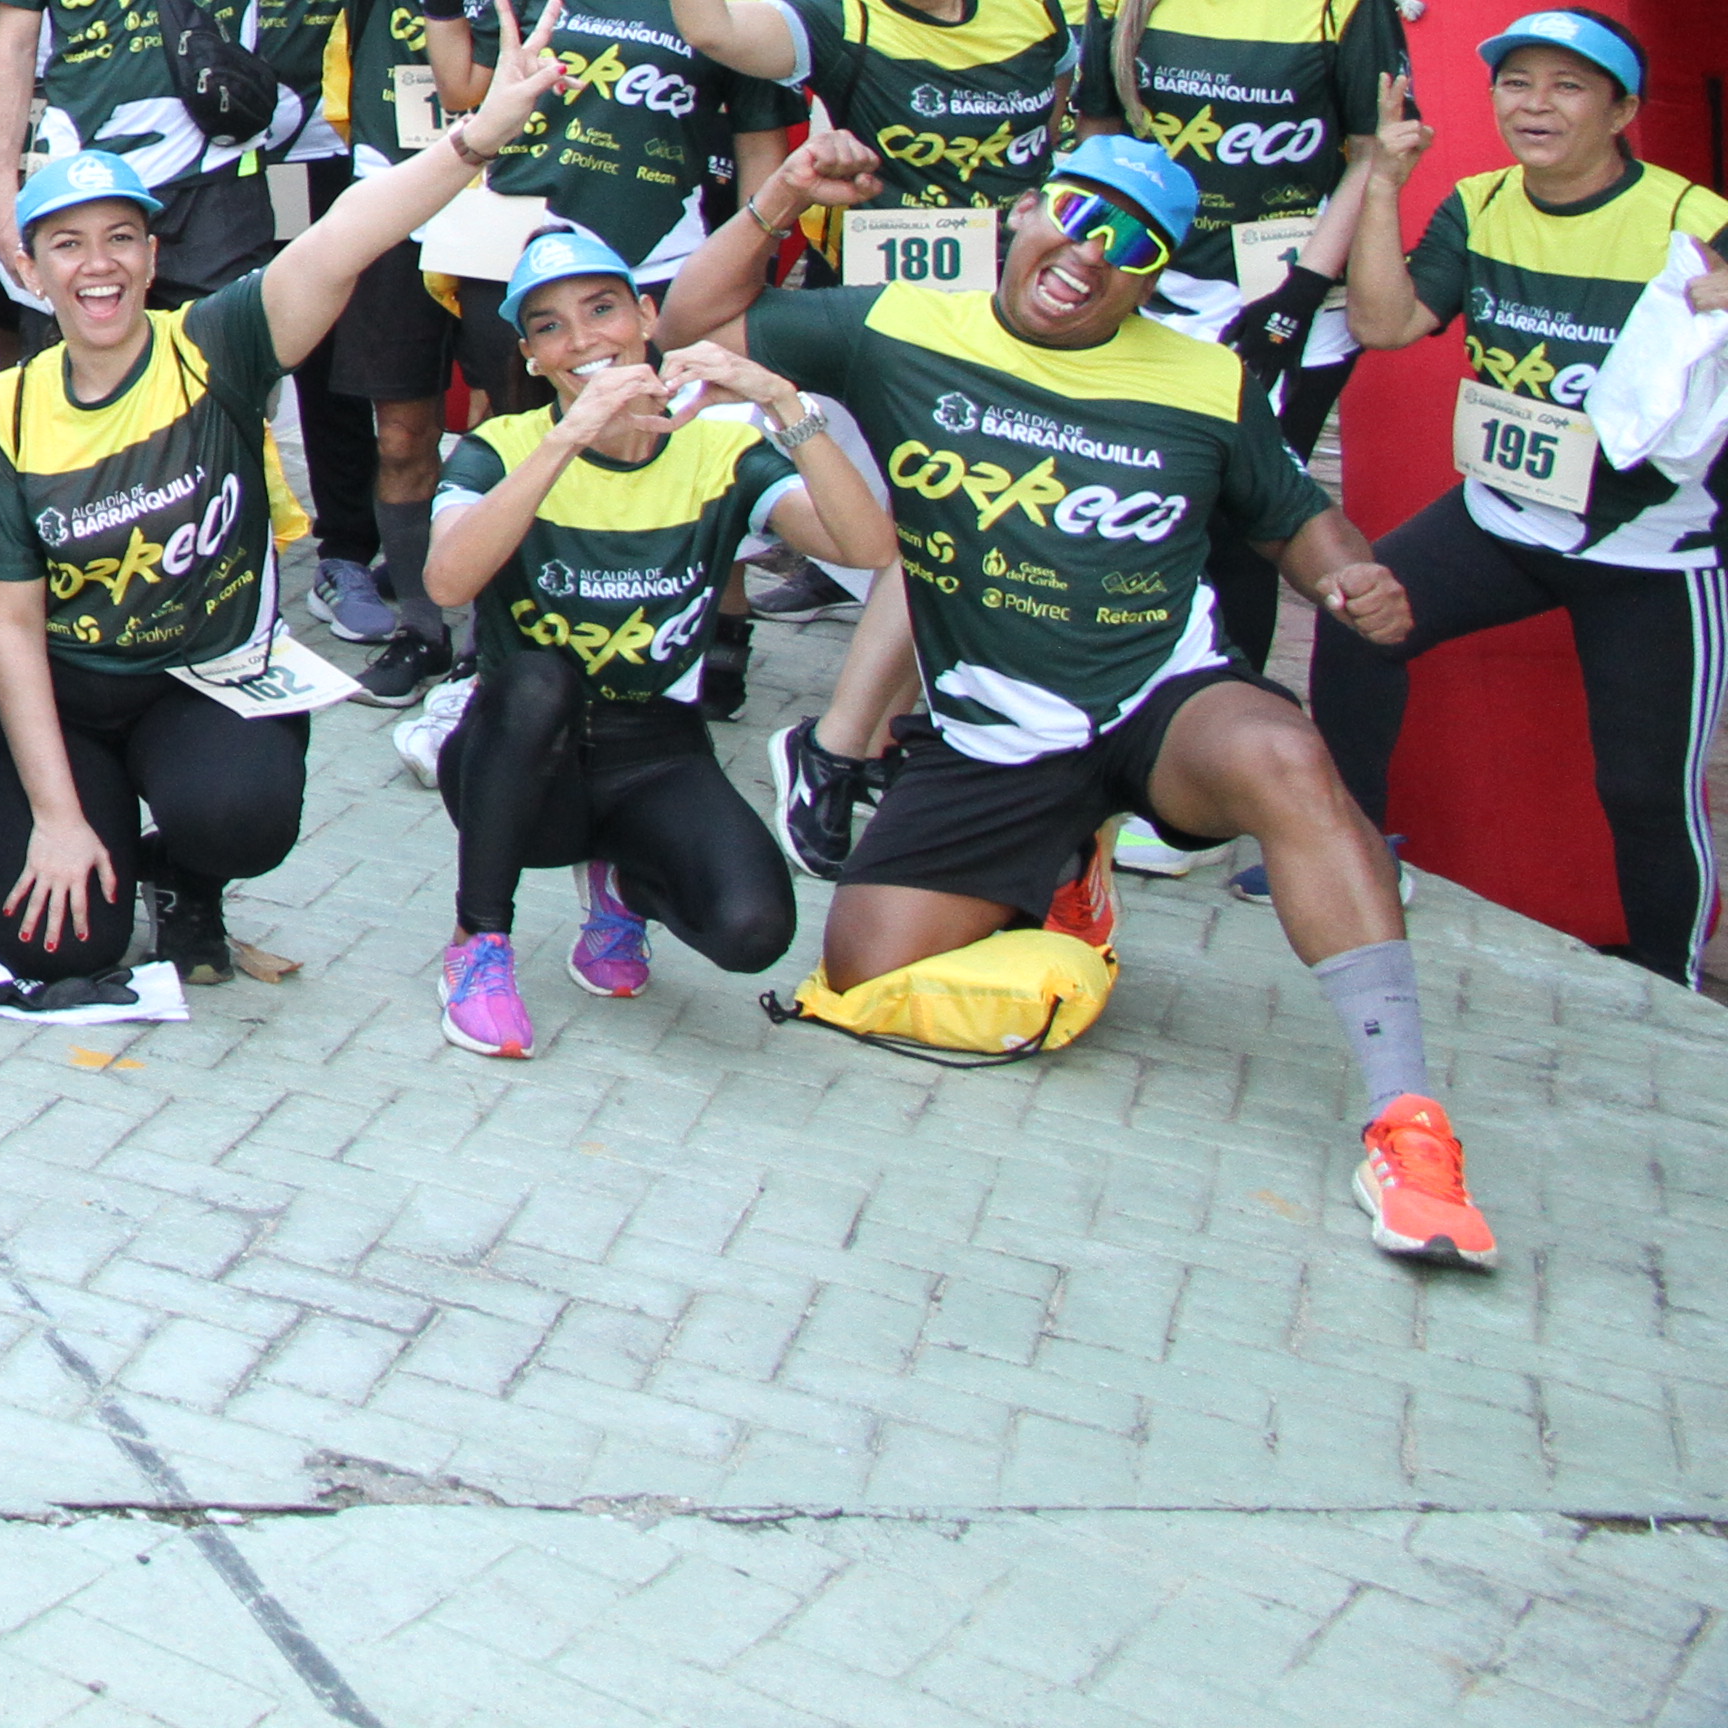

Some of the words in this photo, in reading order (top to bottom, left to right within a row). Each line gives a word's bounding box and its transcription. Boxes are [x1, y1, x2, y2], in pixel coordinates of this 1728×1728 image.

[574, 12, 631, 29] ALCALDÍA
[632, 18, 647, 29] DE
[566, 18, 693, 59] BARRANQUILLA
[1155, 65, 1212, 83] ALCALDÍA
[1215, 73, 1232, 85] DE
[1153, 75, 1295, 104] BARRANQUILLA
[571, 153, 621, 176] Polyrec
[877, 236, 962, 282] 180
[1494, 309, 1618, 345] BARRANQUILL
[1554, 311, 1573, 323] DE
[984, 405, 1059, 435] ALCALDÍA
[1062, 423, 1084, 438] DE
[981, 417, 1162, 470] BARRANQUILLA
[1481, 418, 1559, 481] 195
[71, 489, 129, 521] ALCALDÍA
[130, 483, 146, 499] DE
[580, 567, 642, 583] ALCALDÍA
[645, 566, 663, 580] DE
[1005, 569, 1031, 585] del
[1031, 572, 1068, 592] Caribe
[1018, 560, 1056, 579] Gases
[1004, 591, 1071, 621] Polyrec
[1095, 605, 1169, 626] Retorna
[45, 621, 71, 636] eam
